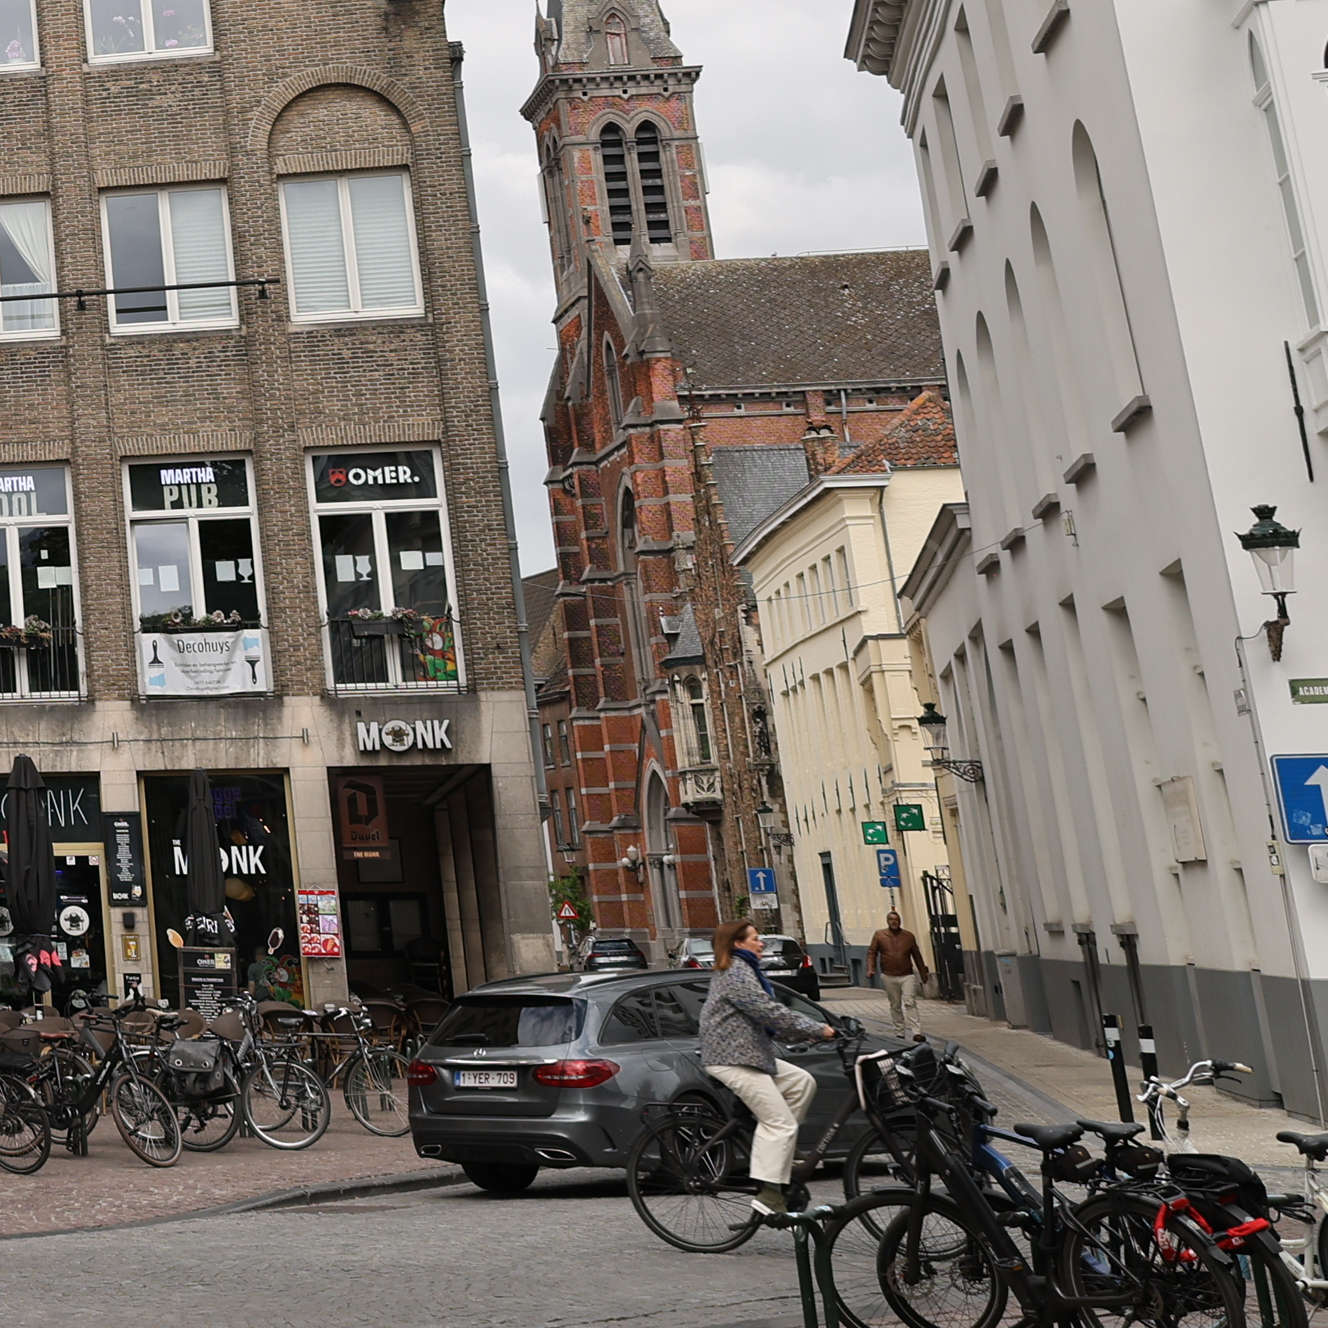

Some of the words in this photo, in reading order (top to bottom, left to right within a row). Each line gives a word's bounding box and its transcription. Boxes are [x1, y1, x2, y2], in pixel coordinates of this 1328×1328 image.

[159, 467, 215, 485] MARTHA
[348, 465, 420, 486] OMER.
[163, 483, 220, 510] PUB
[176, 638, 231, 655] Decohuys
[879, 853, 895, 872] P
